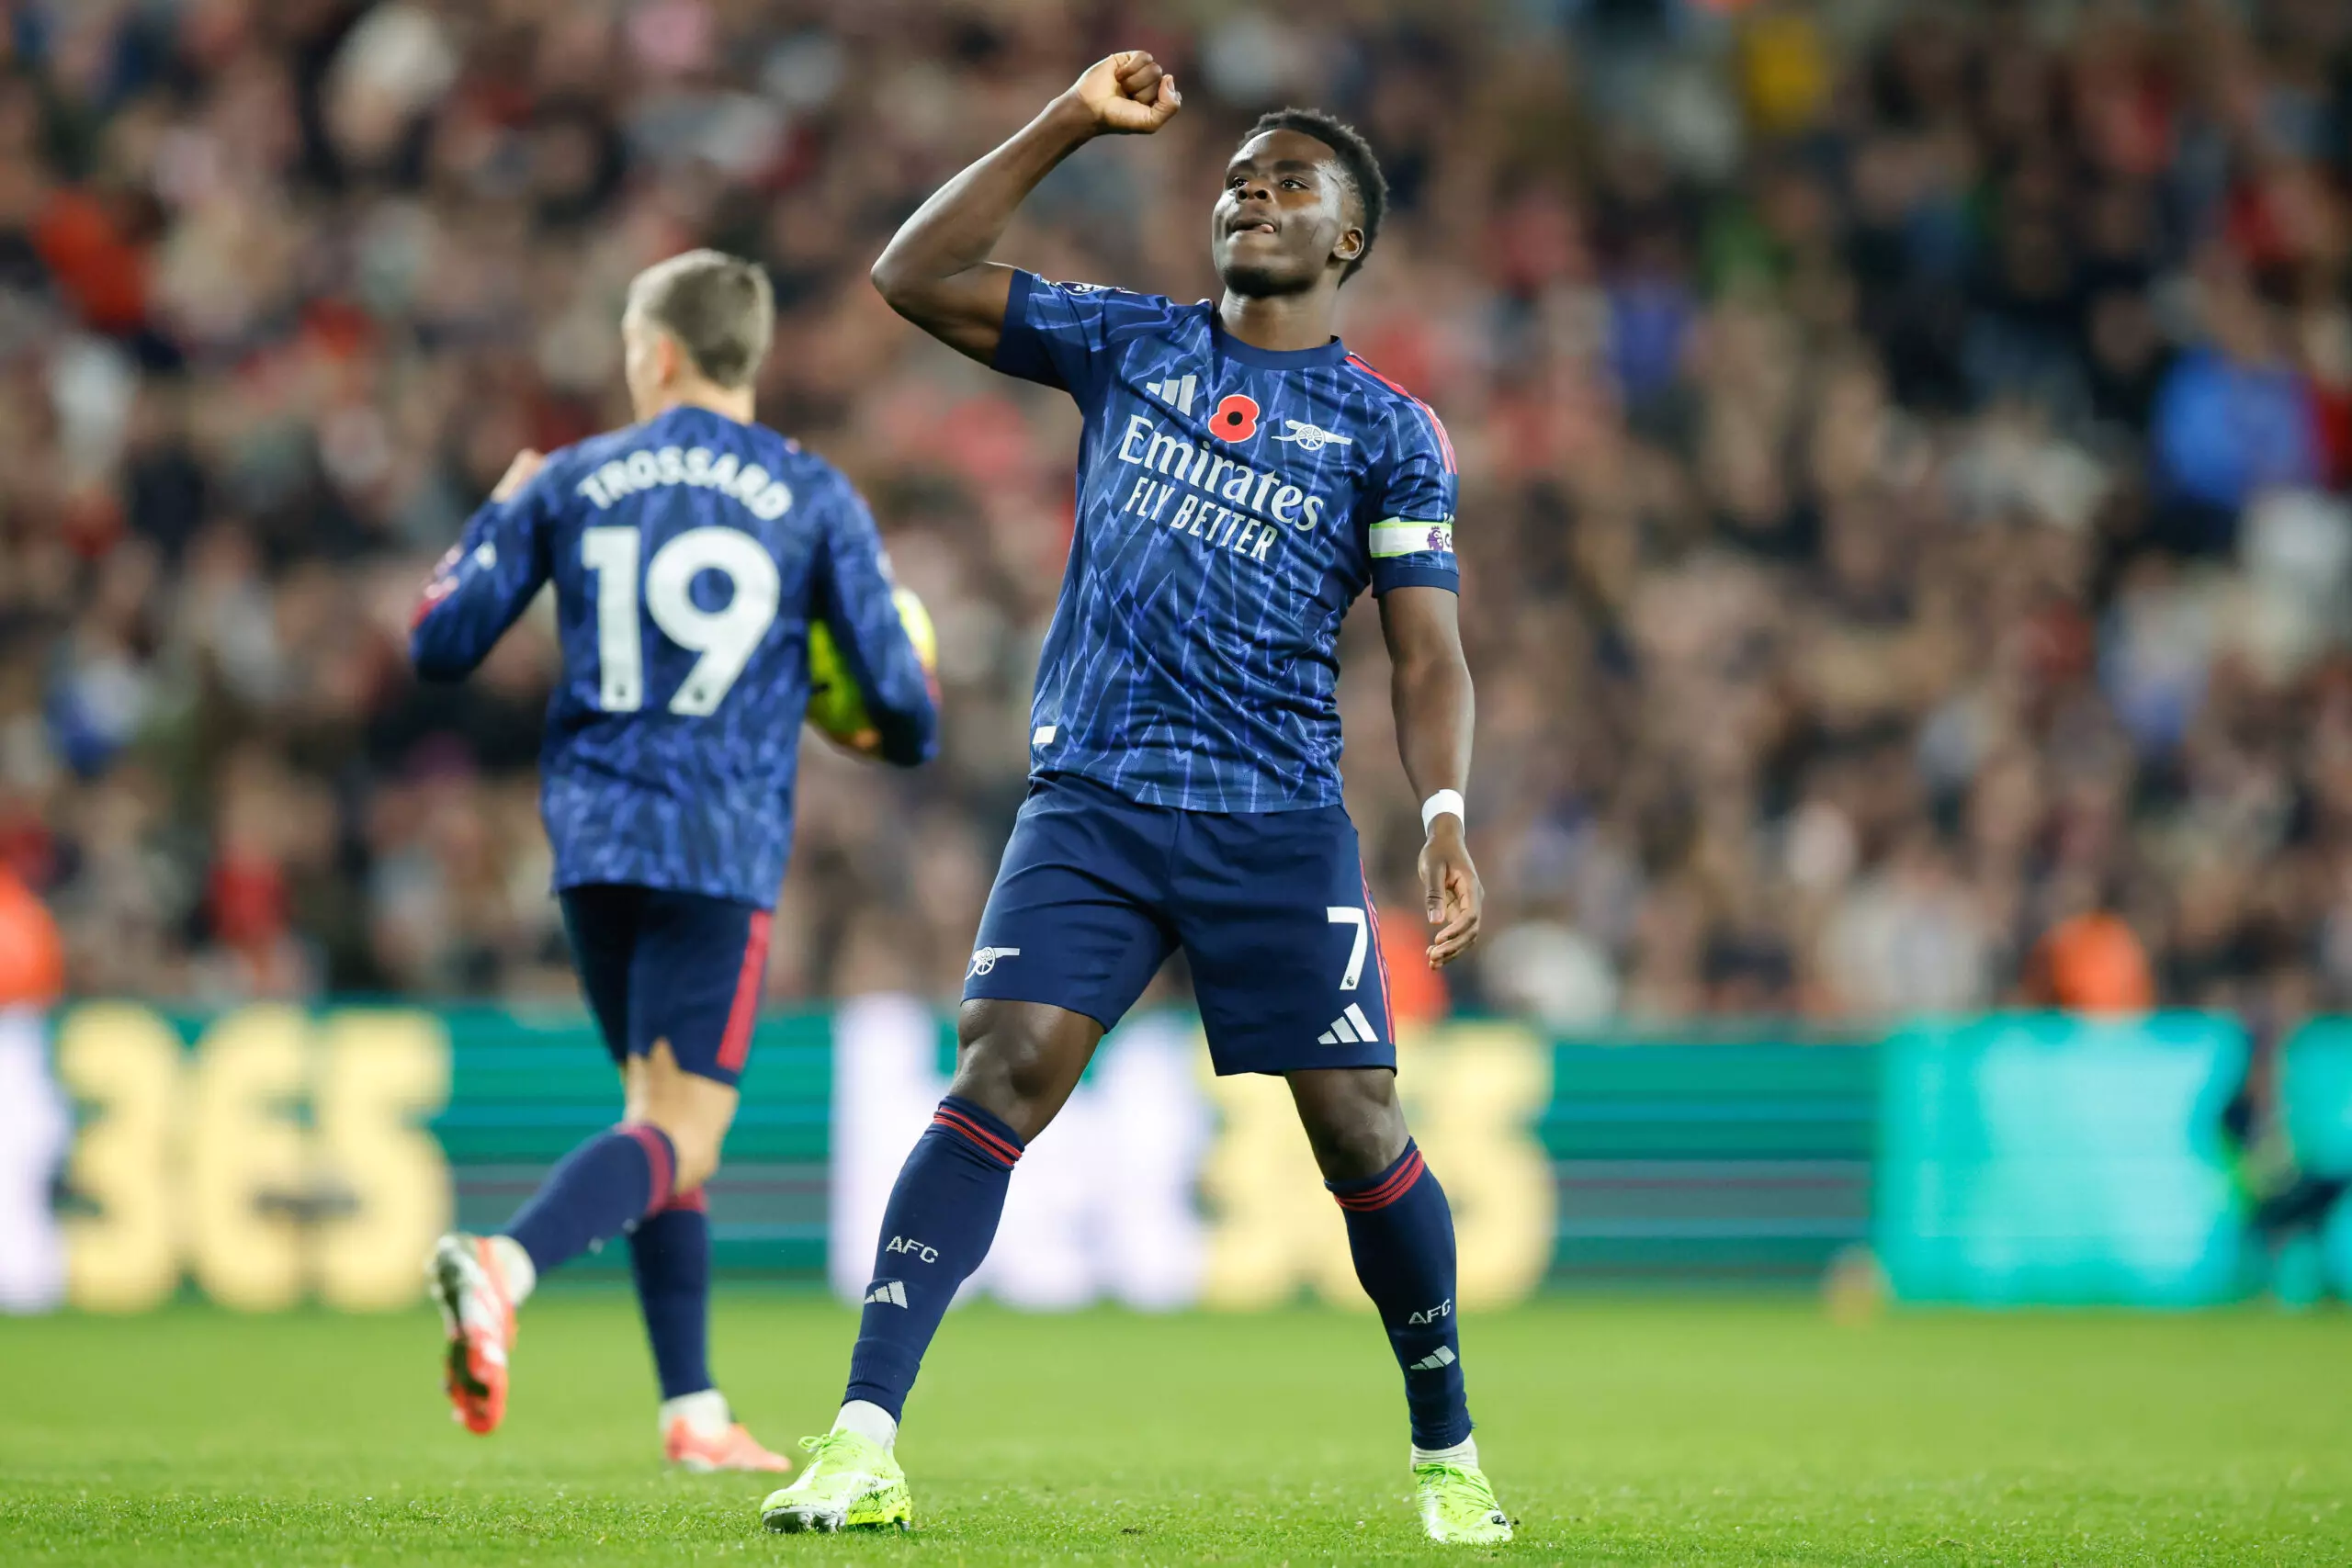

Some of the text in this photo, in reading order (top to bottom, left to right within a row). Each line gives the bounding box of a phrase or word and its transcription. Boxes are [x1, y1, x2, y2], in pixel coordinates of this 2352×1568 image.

[576, 446, 793, 521] TROSSARD
[1118, 414, 1324, 531] Emirates
[1125, 476, 1278, 561] FLY BETTER
[581, 525, 780, 716] 19
[1327, 907, 1368, 990] 7
[886, 1235, 938, 1263] AFC
[1408, 1298, 1451, 1325] AFC
